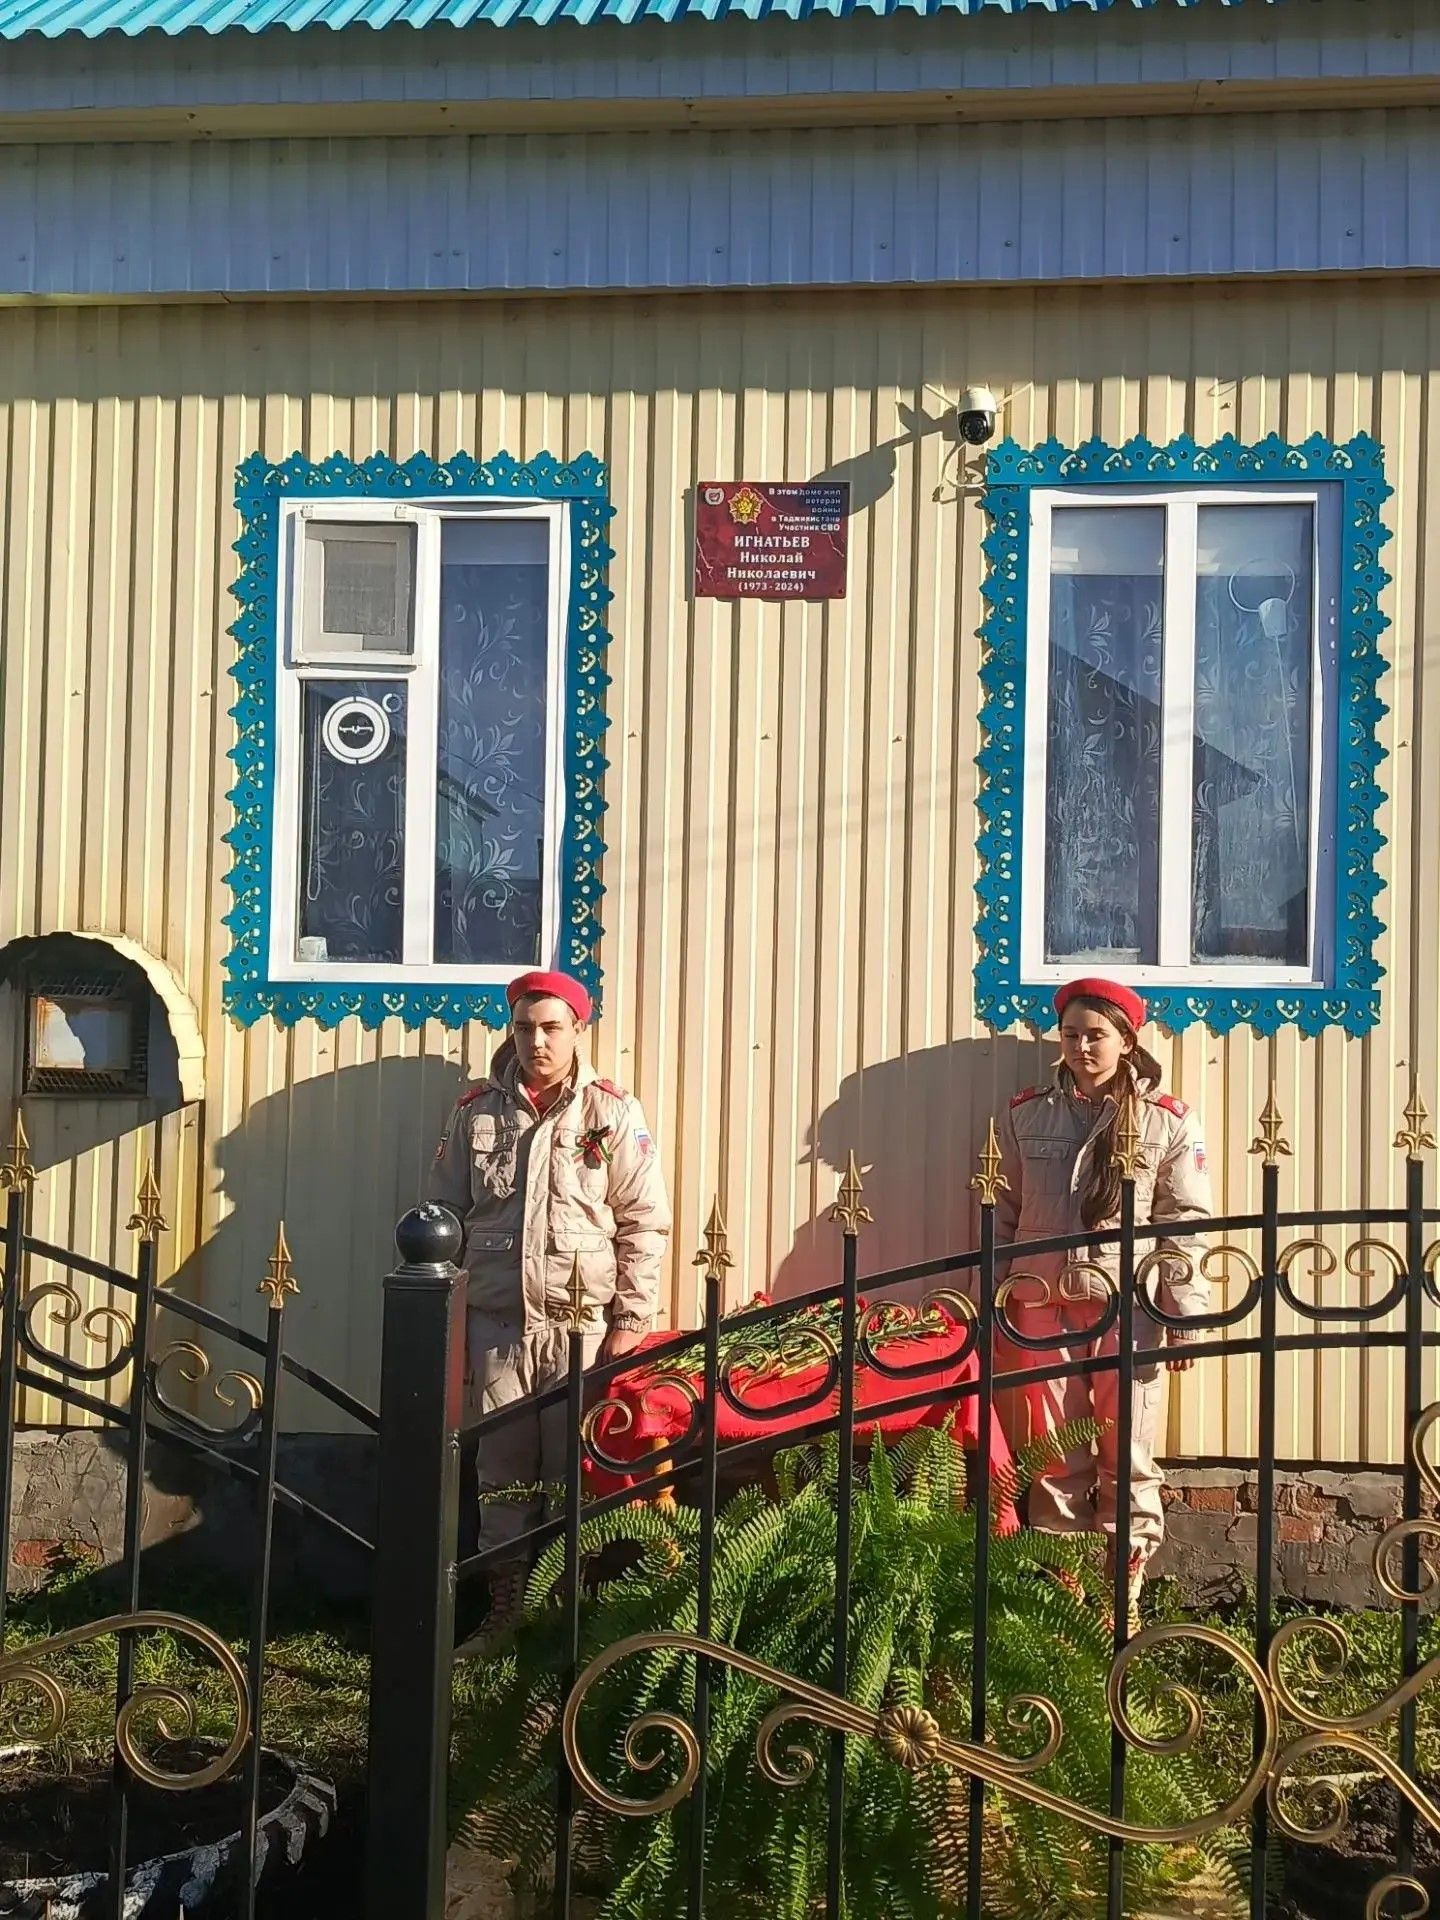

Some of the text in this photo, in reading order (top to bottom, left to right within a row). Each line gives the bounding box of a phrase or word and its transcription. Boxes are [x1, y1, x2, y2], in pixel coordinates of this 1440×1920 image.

[779, 523, 840, 531] Участник СВО
[734, 536, 810, 548] ИГНАТЬЕВ
[740, 552, 803, 563] Николай
[727, 567, 816, 579] Николаевич
